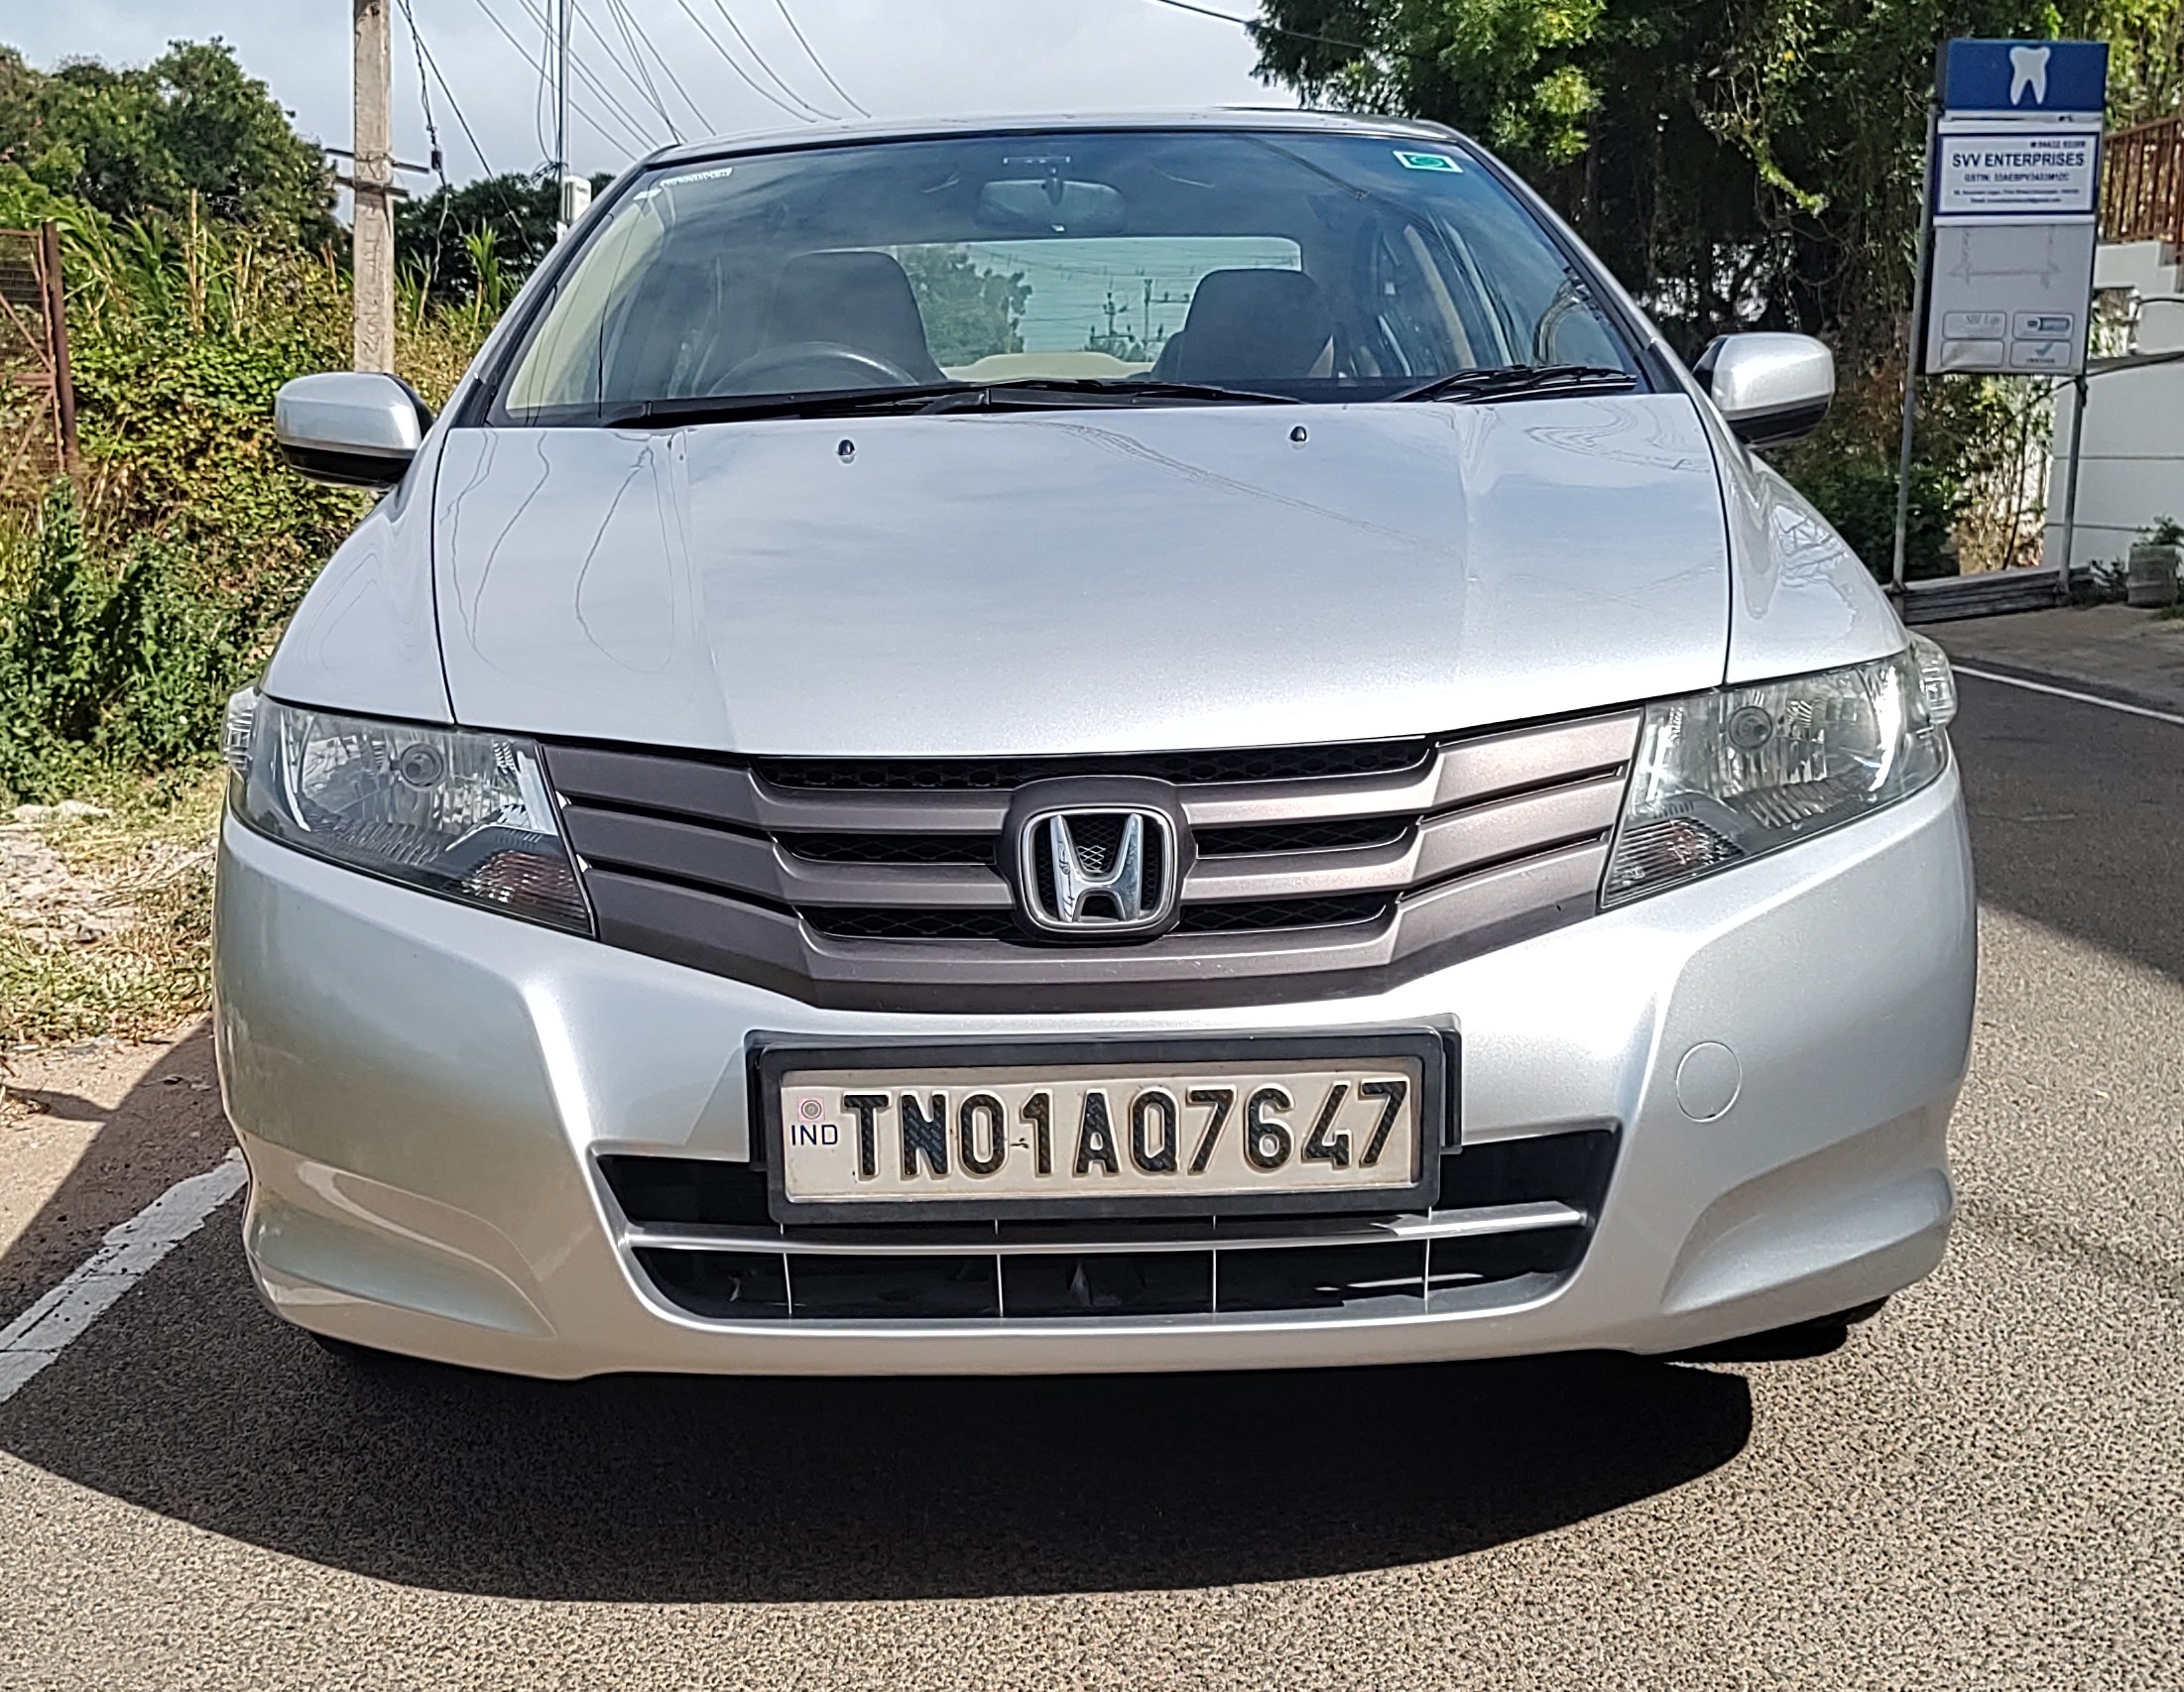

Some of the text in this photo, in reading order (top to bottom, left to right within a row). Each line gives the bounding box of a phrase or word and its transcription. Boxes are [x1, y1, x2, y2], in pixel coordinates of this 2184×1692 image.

[1952, 153, 2085, 168] SVV ENTERPRISES
[791, 1124, 839, 1147] IND
[843, 1080, 1410, 1178] TN01AQ7647
